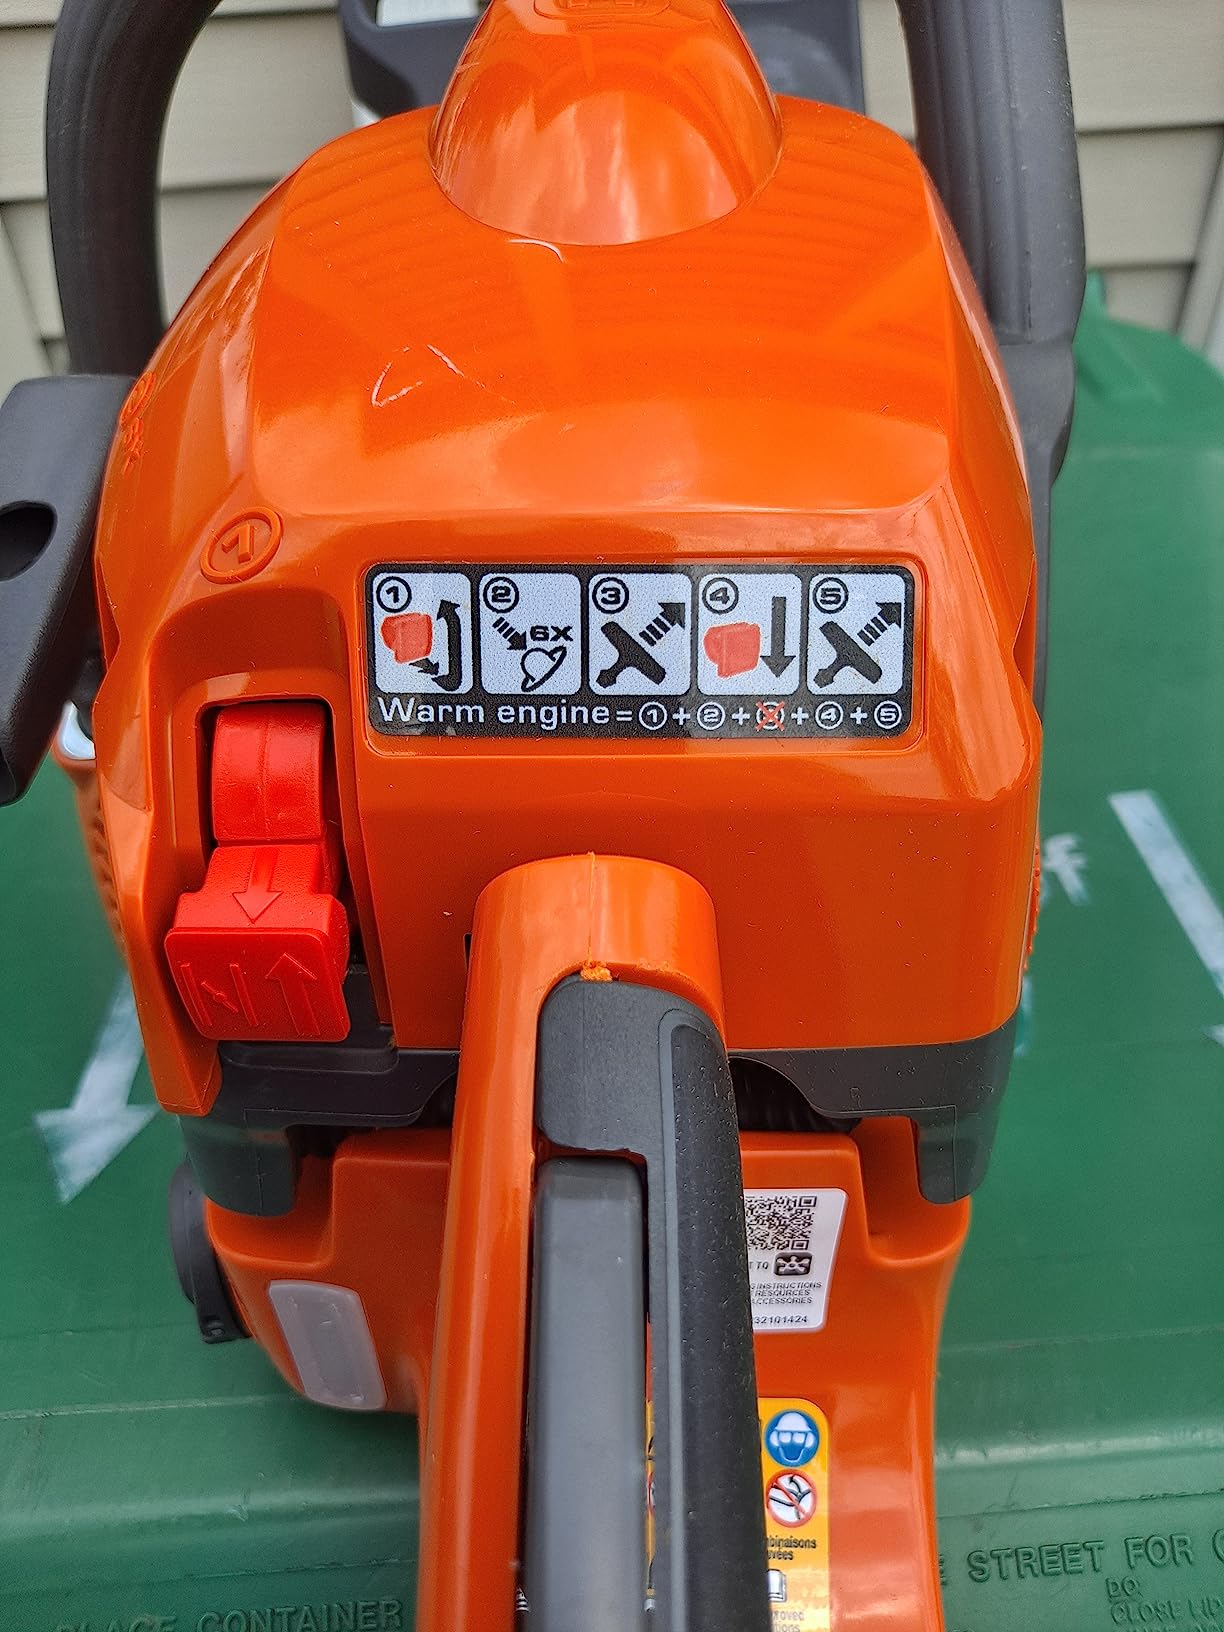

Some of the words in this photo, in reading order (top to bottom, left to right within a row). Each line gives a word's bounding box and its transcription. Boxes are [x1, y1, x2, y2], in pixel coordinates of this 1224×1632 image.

[529, 625, 574, 642] 6X
[377, 696, 485, 724] Warm
[755, 1289, 811, 1297] RESOURCES
[756, 1281, 822, 1290] INSTRUCTIONS
[966, 1540, 1105, 1583] STREET
[1123, 1532, 1193, 1570] FOR
[197, 1599, 402, 1632] CONTAINER
